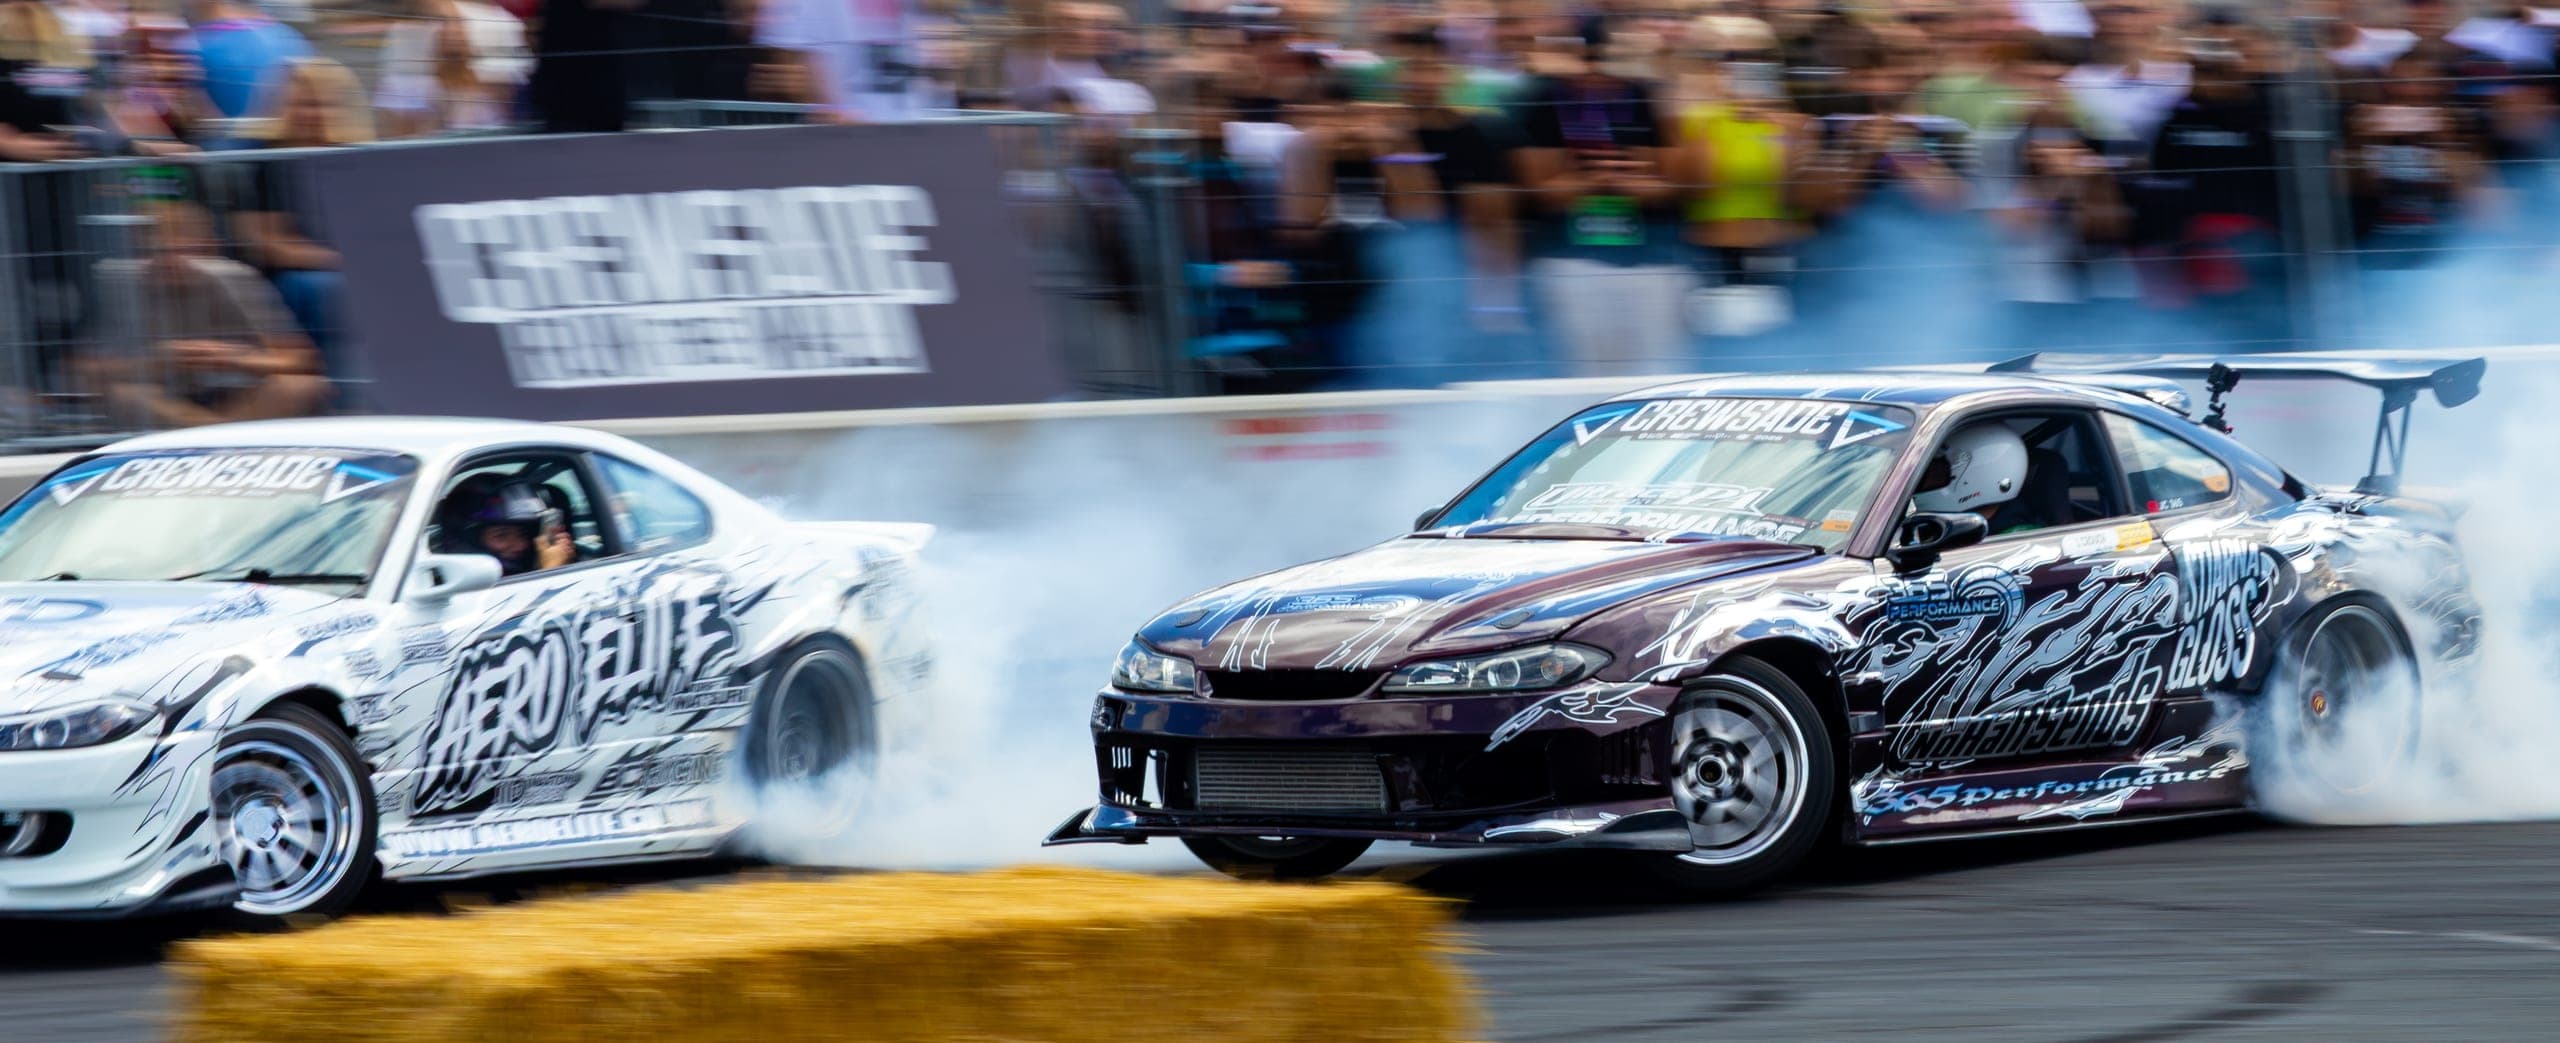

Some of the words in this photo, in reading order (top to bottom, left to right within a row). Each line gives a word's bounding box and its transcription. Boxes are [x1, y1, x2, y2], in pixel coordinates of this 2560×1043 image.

[1620, 401, 1849, 435] CREWSADE
[100, 455, 341, 491] CREWSADE
[1889, 598, 2000, 620] PERFORMANCE
[2164, 577, 2256, 691] GLOSS
[421, 628, 571, 807] AERO
[579, 572, 732, 739] ELITE
